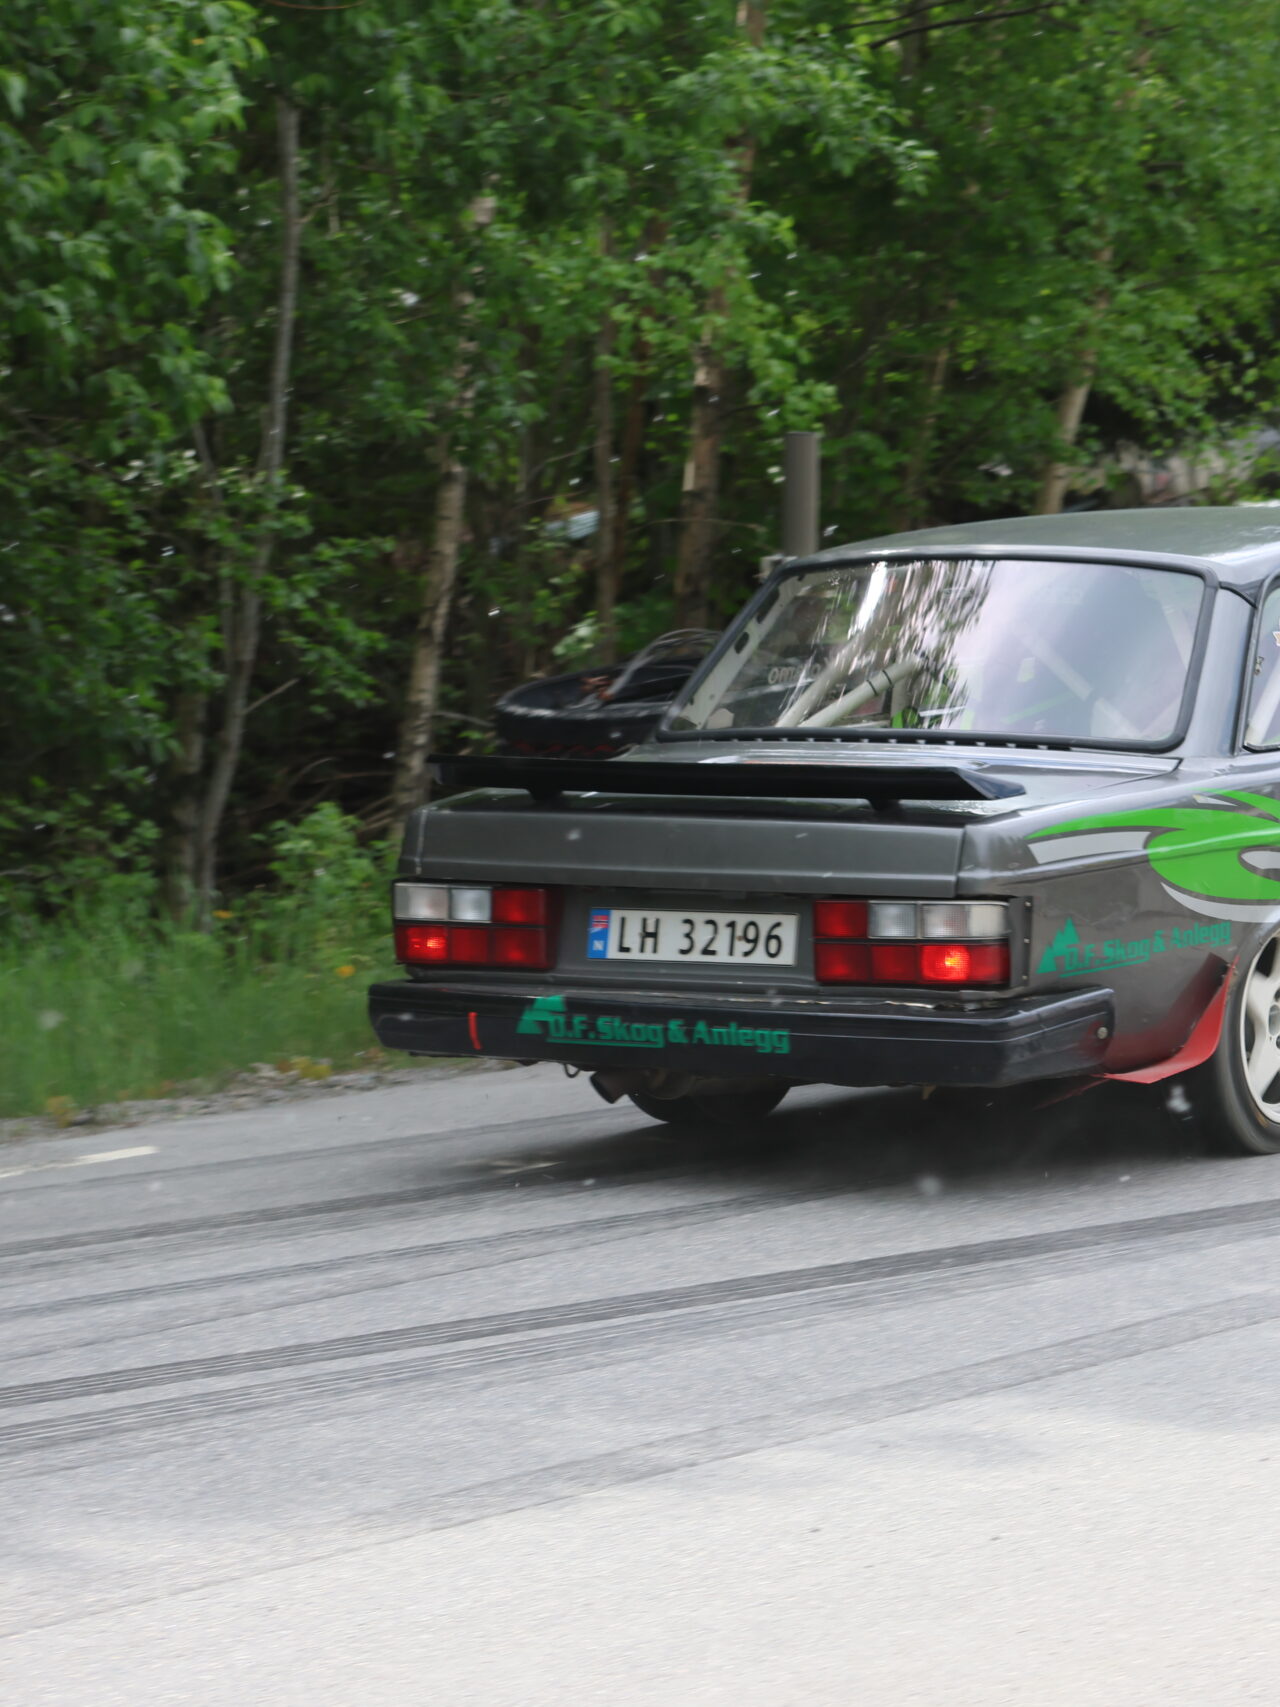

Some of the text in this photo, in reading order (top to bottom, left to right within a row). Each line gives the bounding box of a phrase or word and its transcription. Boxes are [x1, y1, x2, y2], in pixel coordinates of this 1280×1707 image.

[617, 916, 661, 954] LH
[678, 918, 784, 959] 32196
[1153, 929, 1166, 953] &
[1168, 920, 1232, 949] Anlegg
[667, 1018, 689, 1044] &
[692, 1020, 791, 1054] Anlegg
